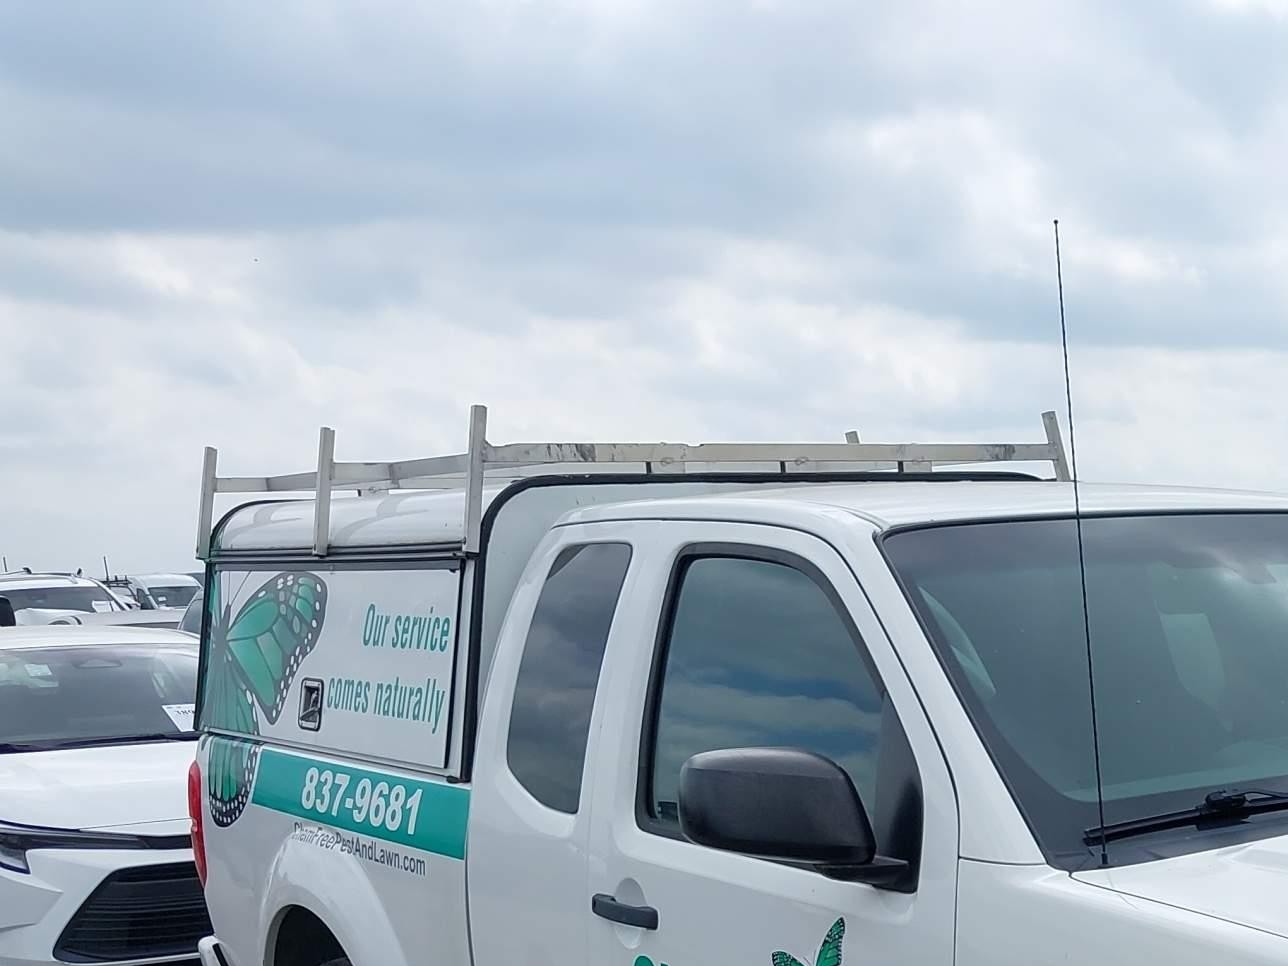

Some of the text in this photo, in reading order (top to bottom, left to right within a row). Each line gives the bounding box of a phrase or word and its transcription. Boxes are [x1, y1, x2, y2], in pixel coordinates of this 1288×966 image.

[362, 603, 451, 652] Our service
[326, 675, 446, 734] comes naturally
[300, 766, 424, 836] 837-9681
